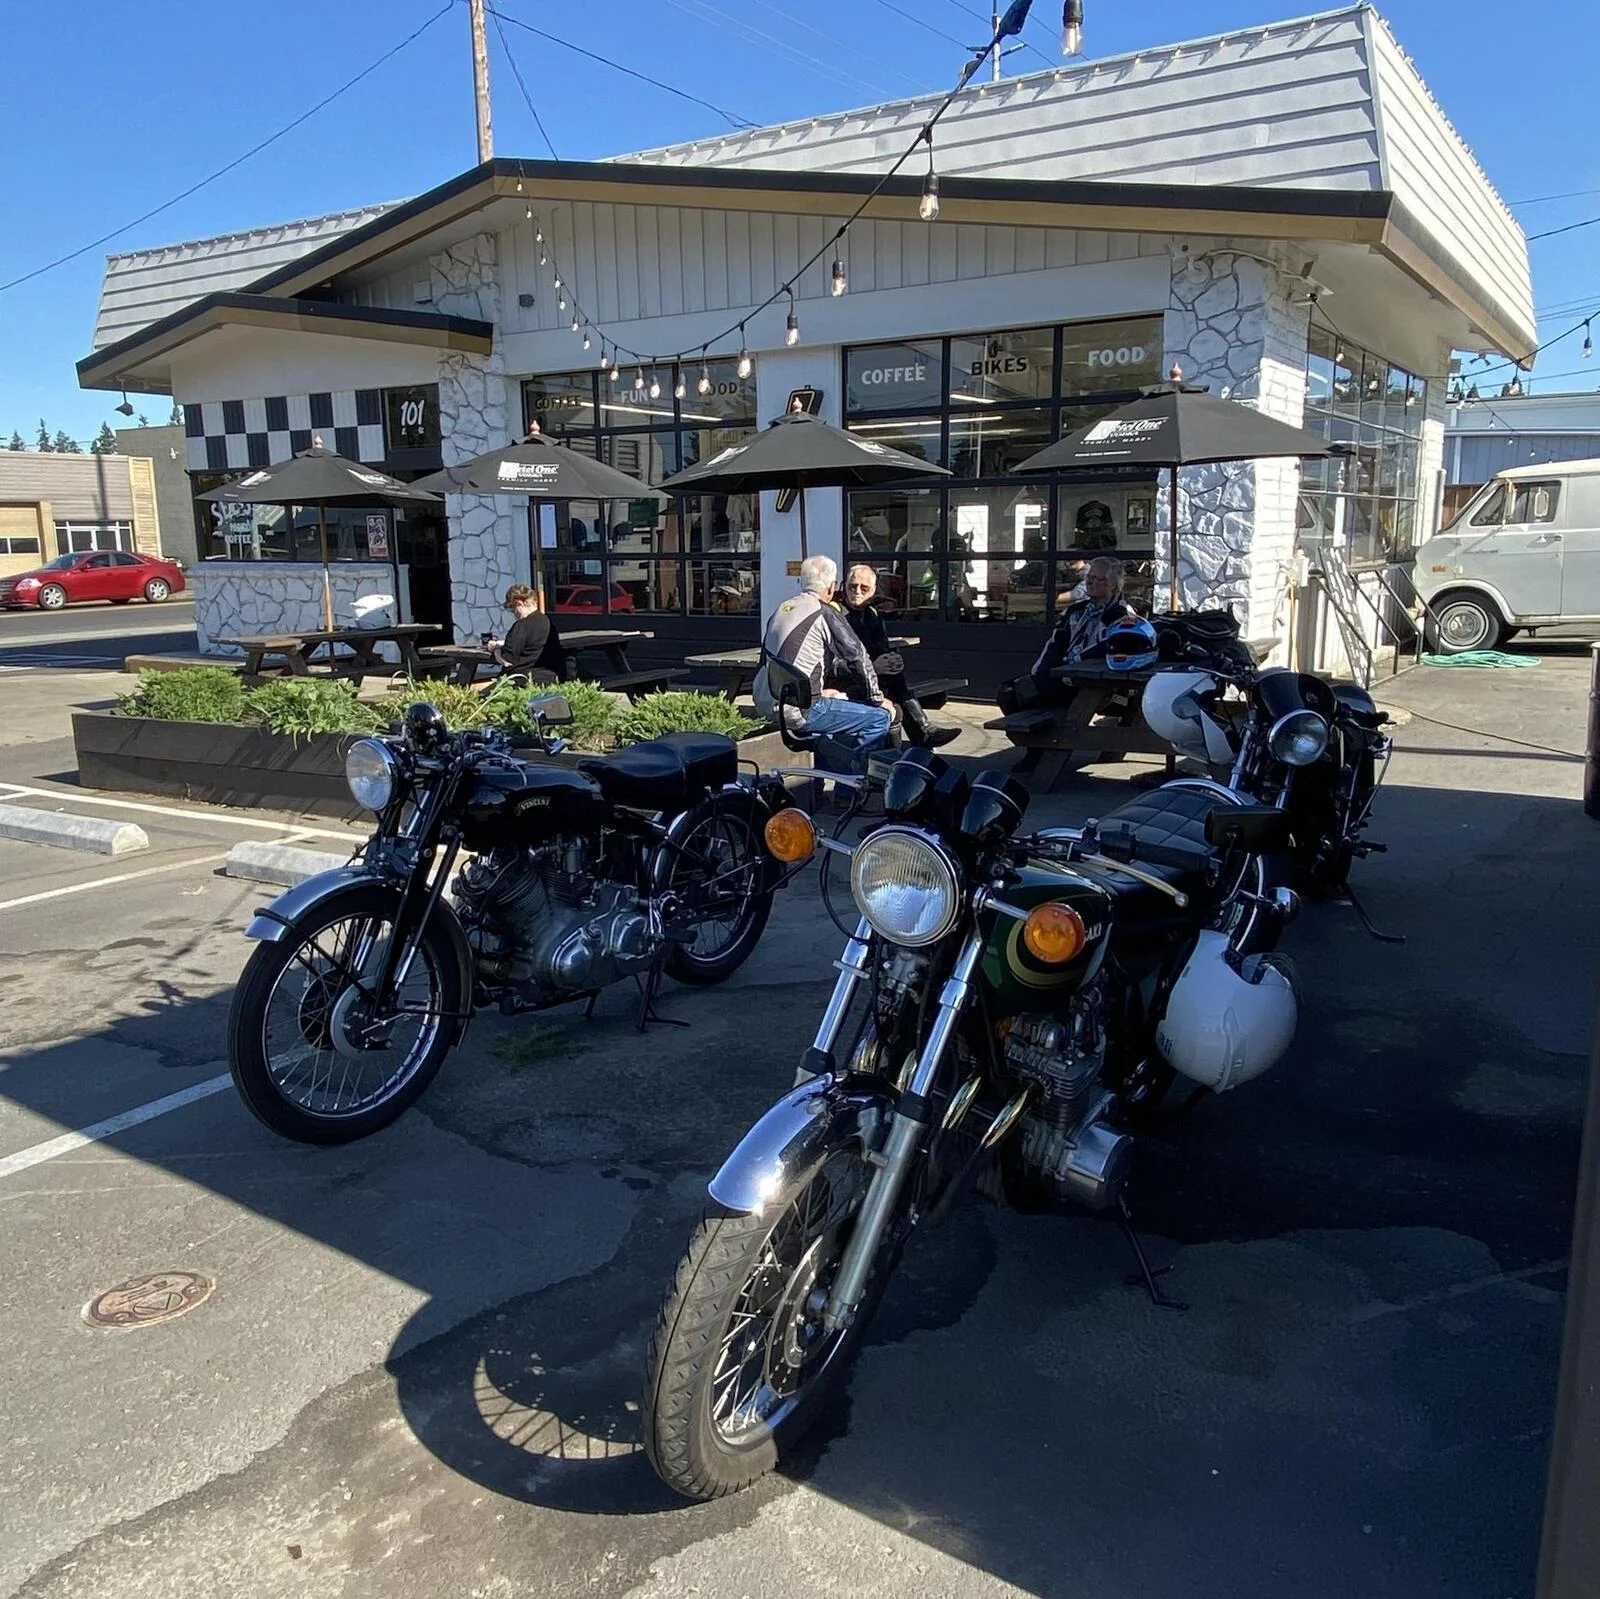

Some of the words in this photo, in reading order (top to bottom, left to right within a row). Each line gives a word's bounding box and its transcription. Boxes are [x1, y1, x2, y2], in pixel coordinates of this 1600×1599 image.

[971, 357, 1028, 376] BIKES
[1088, 346, 1145, 367] FOOD
[861, 365, 926, 385] COFFEE
[620, 389, 650, 404] FUN
[401, 399, 425, 426] 101
